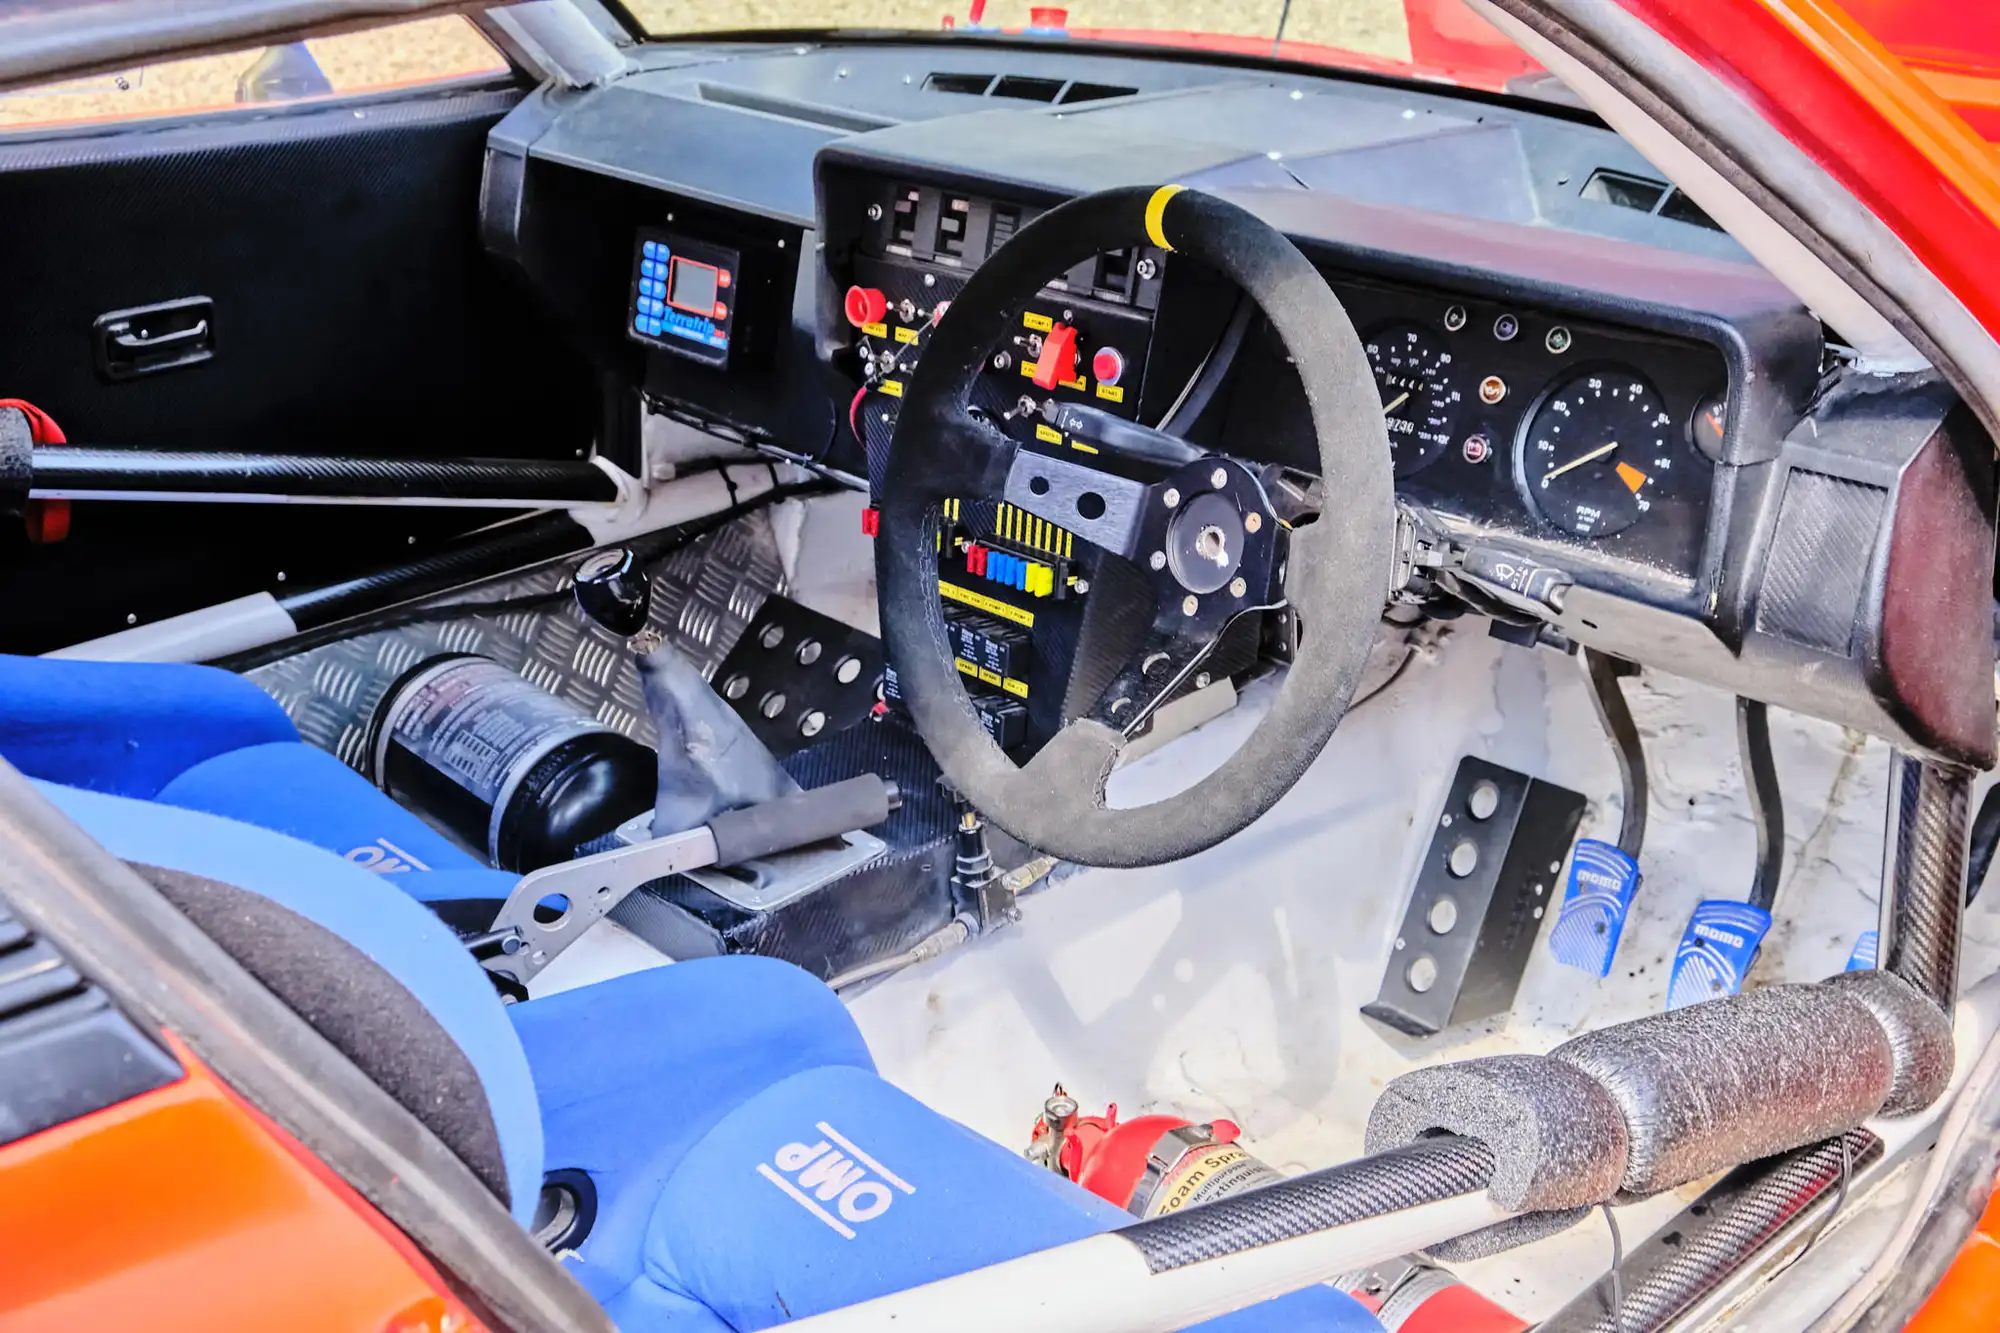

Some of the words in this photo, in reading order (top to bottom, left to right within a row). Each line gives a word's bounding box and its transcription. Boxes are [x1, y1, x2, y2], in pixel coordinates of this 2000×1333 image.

[1407, 333, 1418, 343] 70
[1589, 378, 1602, 389] 30
[1629, 383, 1643, 395] 40
[1553, 401, 1566, 411] 20
[1538, 440, 1549, 451] 10
[1541, 478, 1548, 489] 0
[1576, 505, 1600, 519] RPM
[1637, 500, 1650, 512] 70
[344, 847, 411, 873] OM
[1576, 869, 1622, 891] momo
[1694, 923, 1745, 948] momo
[775, 1140, 893, 1223] OMP
[1159, 1171, 1206, 1216] Foam
